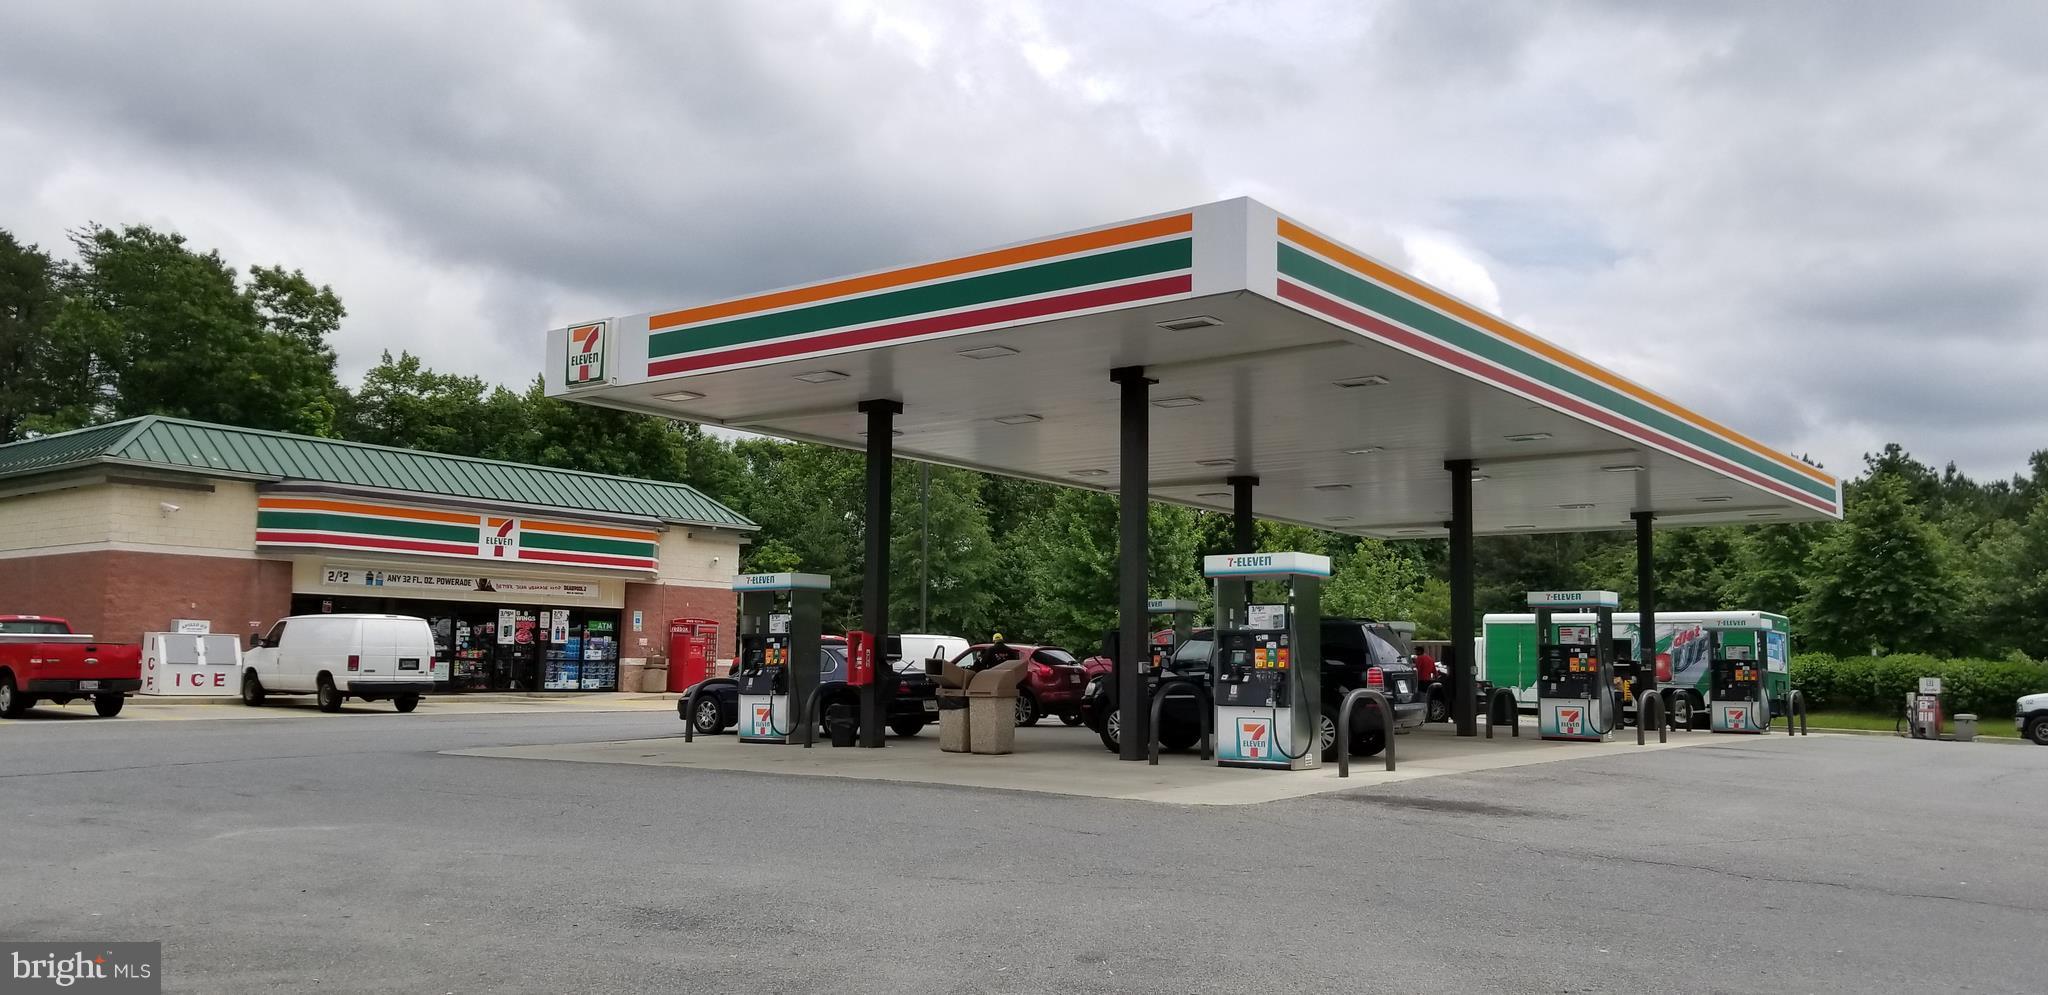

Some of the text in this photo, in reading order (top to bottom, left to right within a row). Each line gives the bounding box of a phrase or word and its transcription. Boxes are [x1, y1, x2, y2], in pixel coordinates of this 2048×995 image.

[573, 326, 599, 380] 7
[488, 517, 513, 557] 7
[387, 574, 401, 583] ANY
[402, 575, 412, 583] 32
[413, 576, 423, 584] FL.
[424, 577, 435, 585] OZ.
[436, 578, 472, 587] POWERADE
[597, 622, 613, 630] ATM
[1673, 625, 1702, 648] diet
[175, 672, 226, 687] ICE
[1243, 724, 1265, 757] 7
